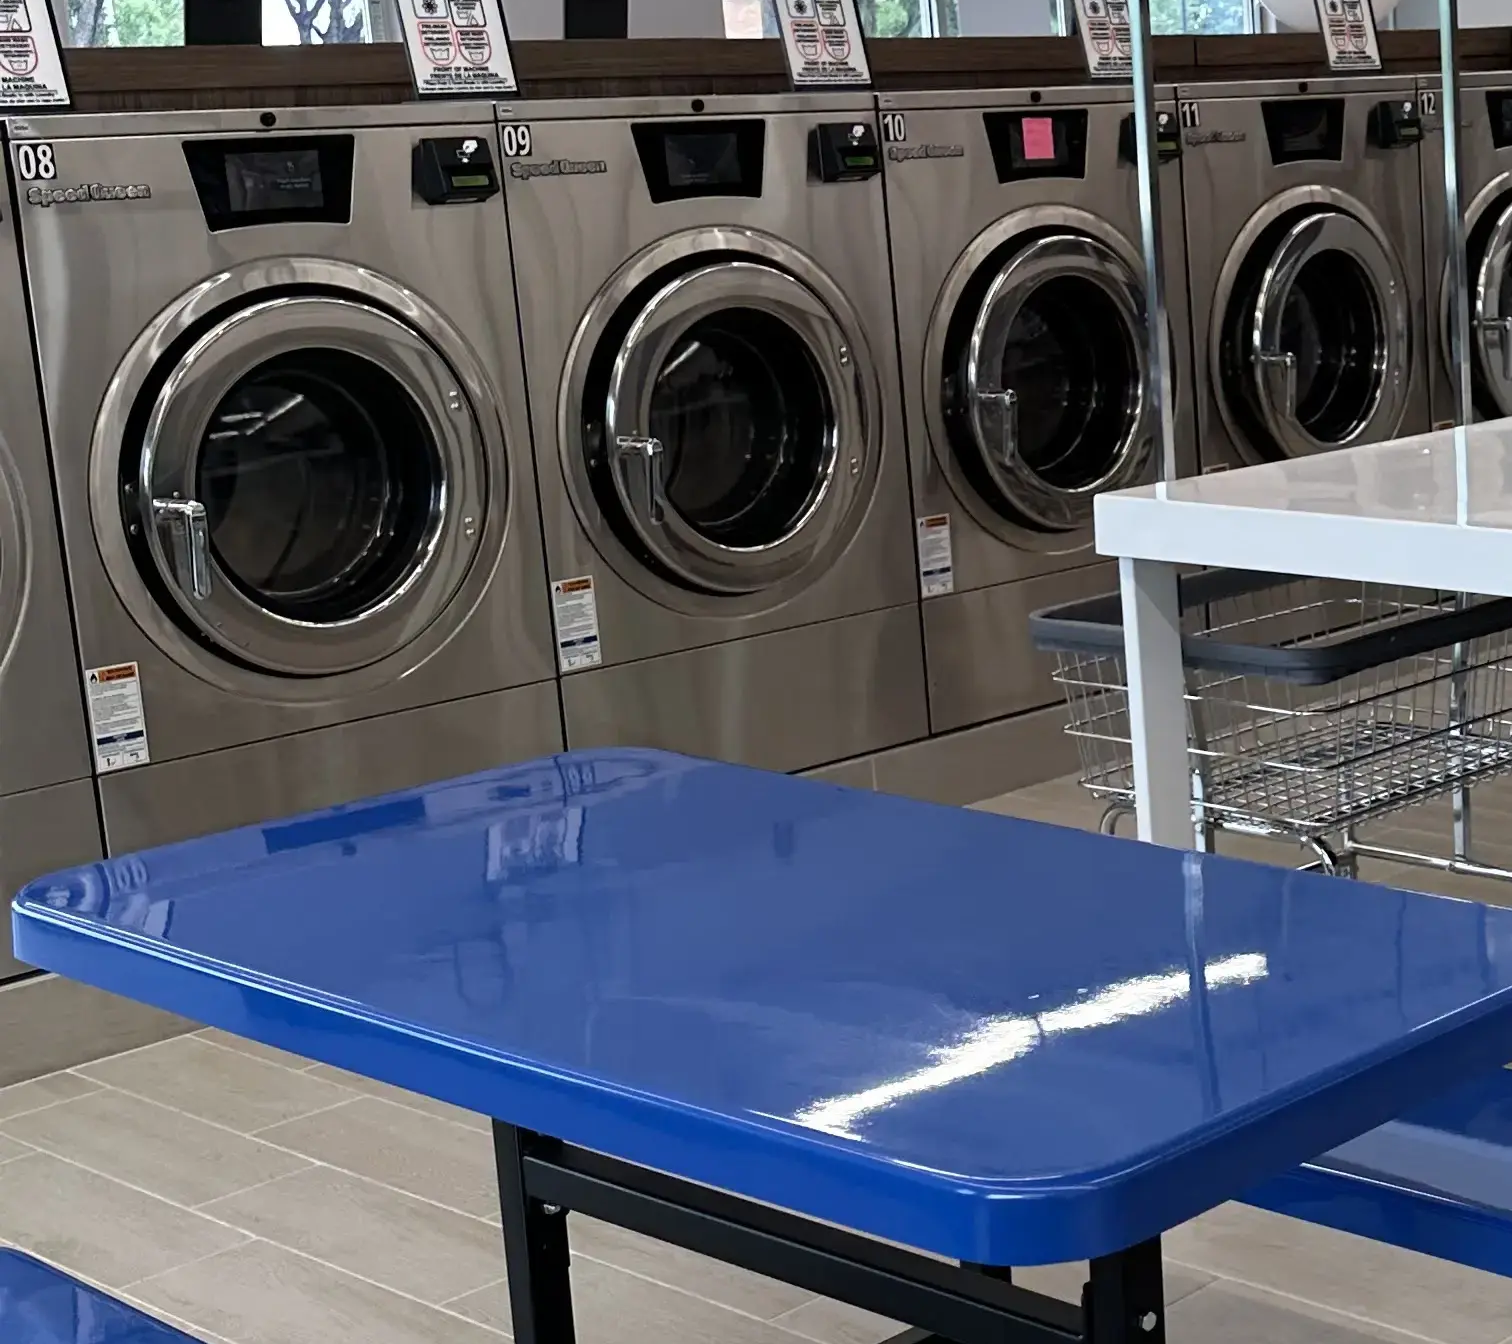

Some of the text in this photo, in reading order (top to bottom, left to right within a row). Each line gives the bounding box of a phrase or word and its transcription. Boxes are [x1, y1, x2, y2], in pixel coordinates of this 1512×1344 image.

[1182, 102, 1200, 127] 11
[1421, 92, 1436, 114] 12
[503, 125, 531, 156] 09
[883, 114, 905, 141] 10
[19, 144, 55, 179] 08
[27, 184, 90, 207] Speed
